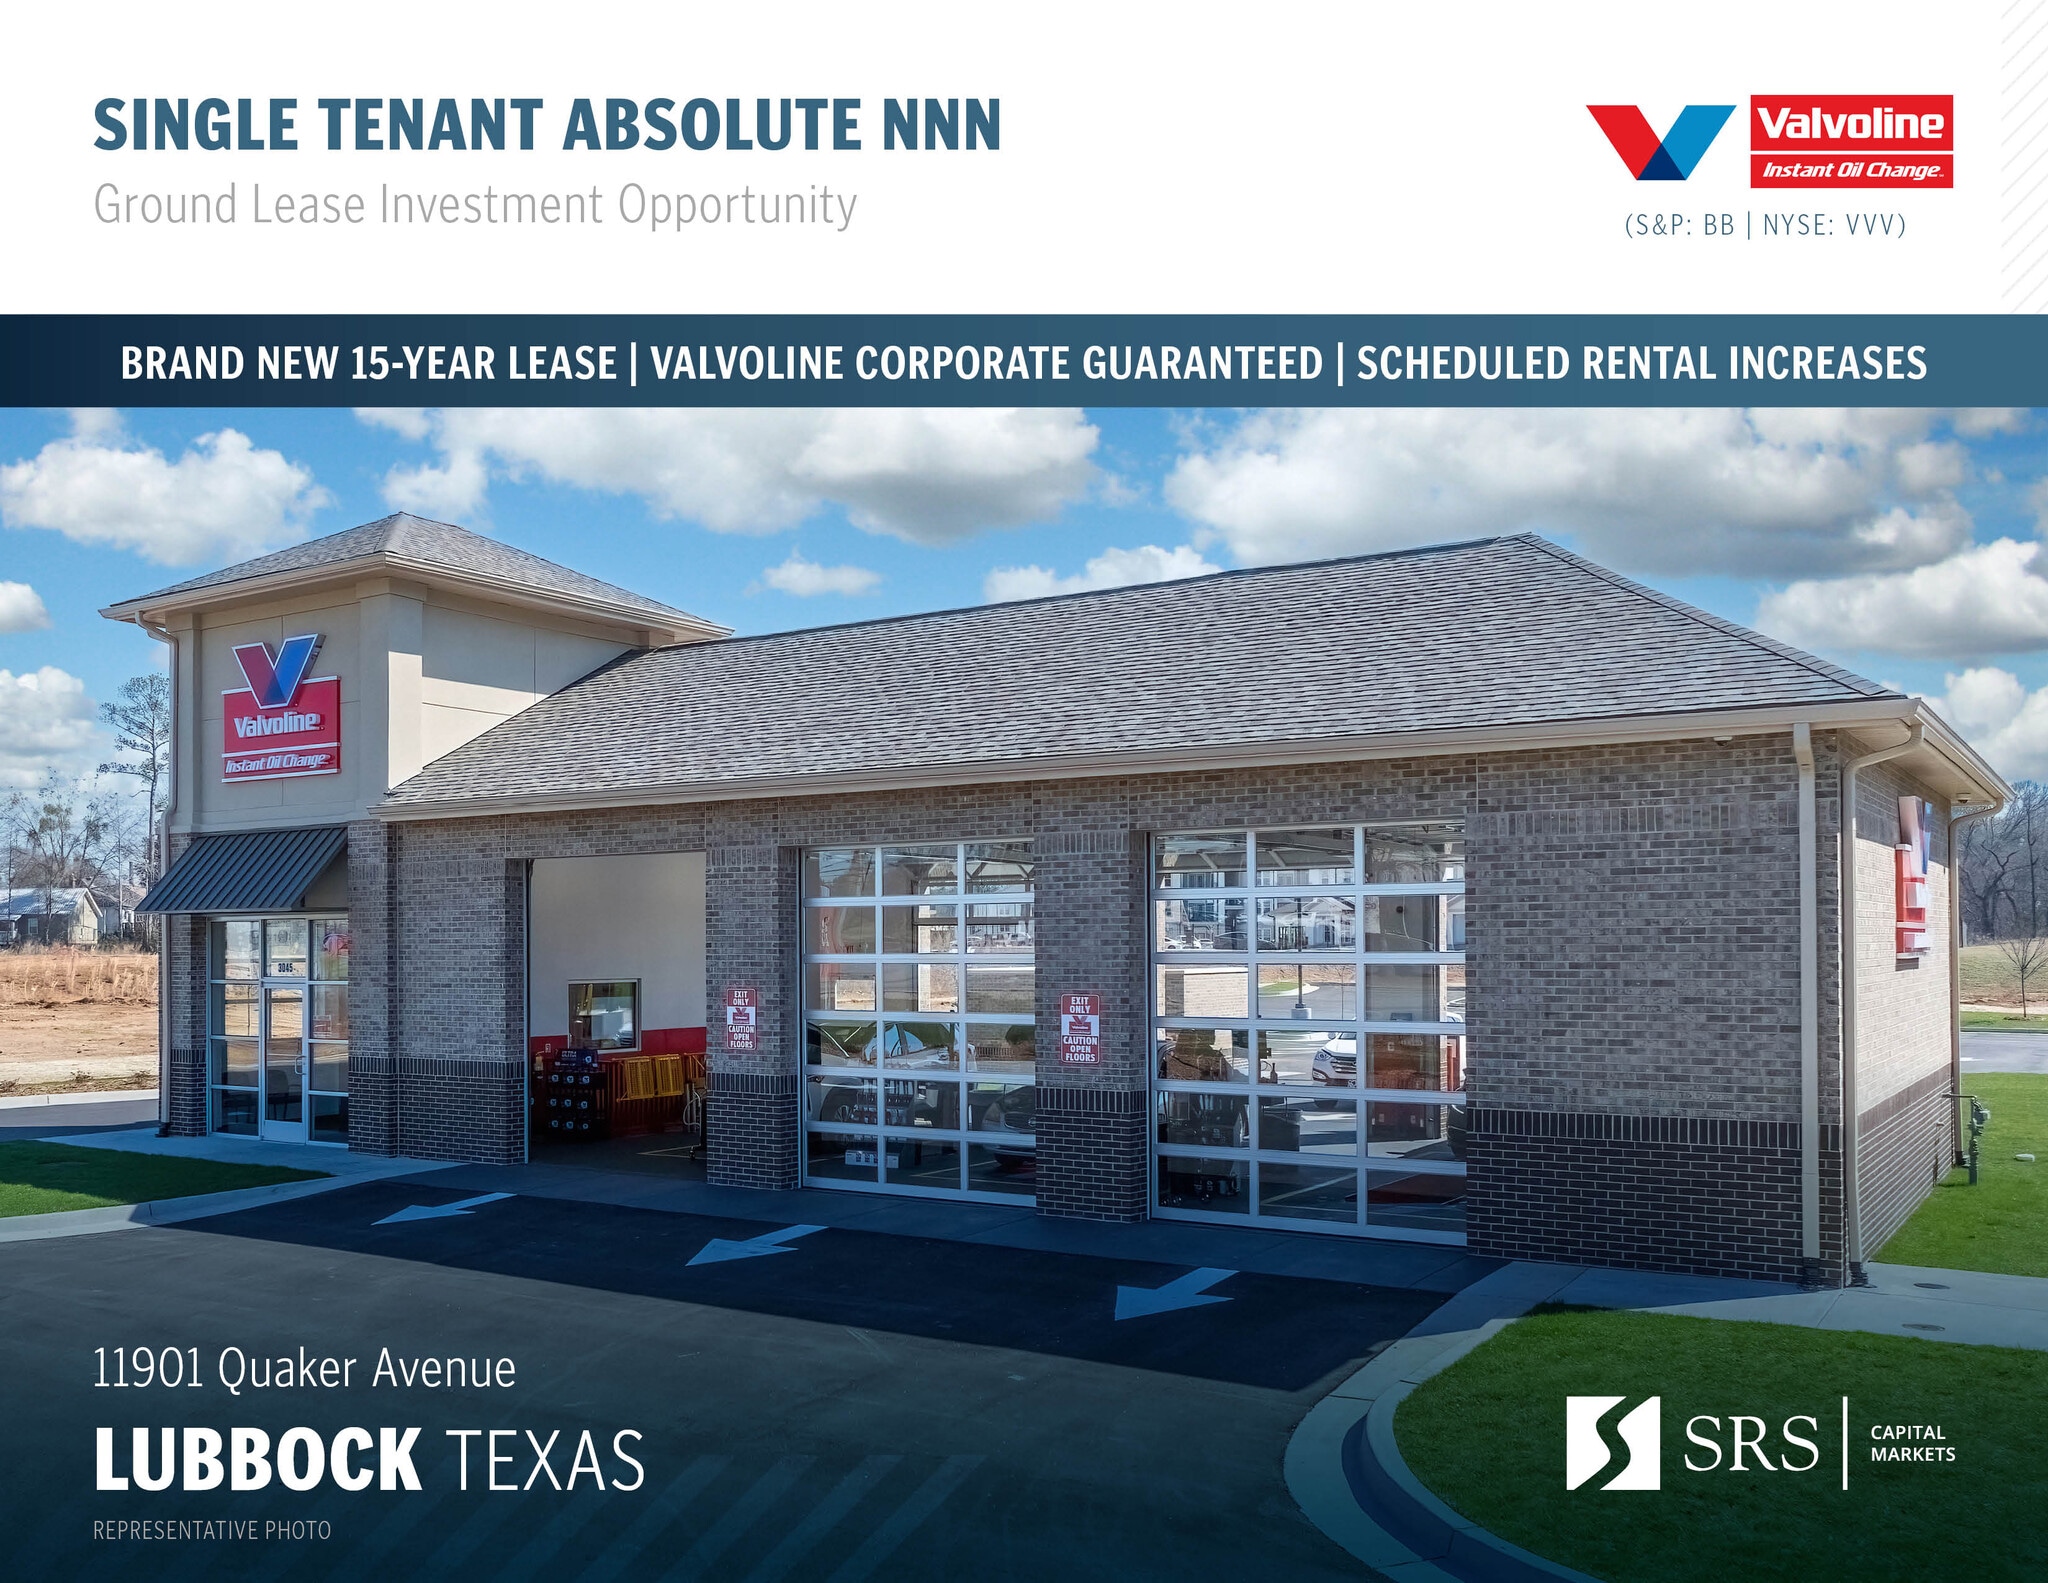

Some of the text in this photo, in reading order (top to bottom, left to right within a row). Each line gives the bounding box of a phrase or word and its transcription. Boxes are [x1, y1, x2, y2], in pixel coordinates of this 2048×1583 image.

[233, 711, 321, 738] Valvoline
[225, 753, 328, 773] Instant Oil Change
[278, 963, 293, 972] 3045
[1071, 997, 1089, 1005] EXIT
[733, 1033, 750, 1041] OPEN
[1063, 1037, 1097, 1045] CAUTION
[1065, 1053, 1096, 1061] FLOORS
